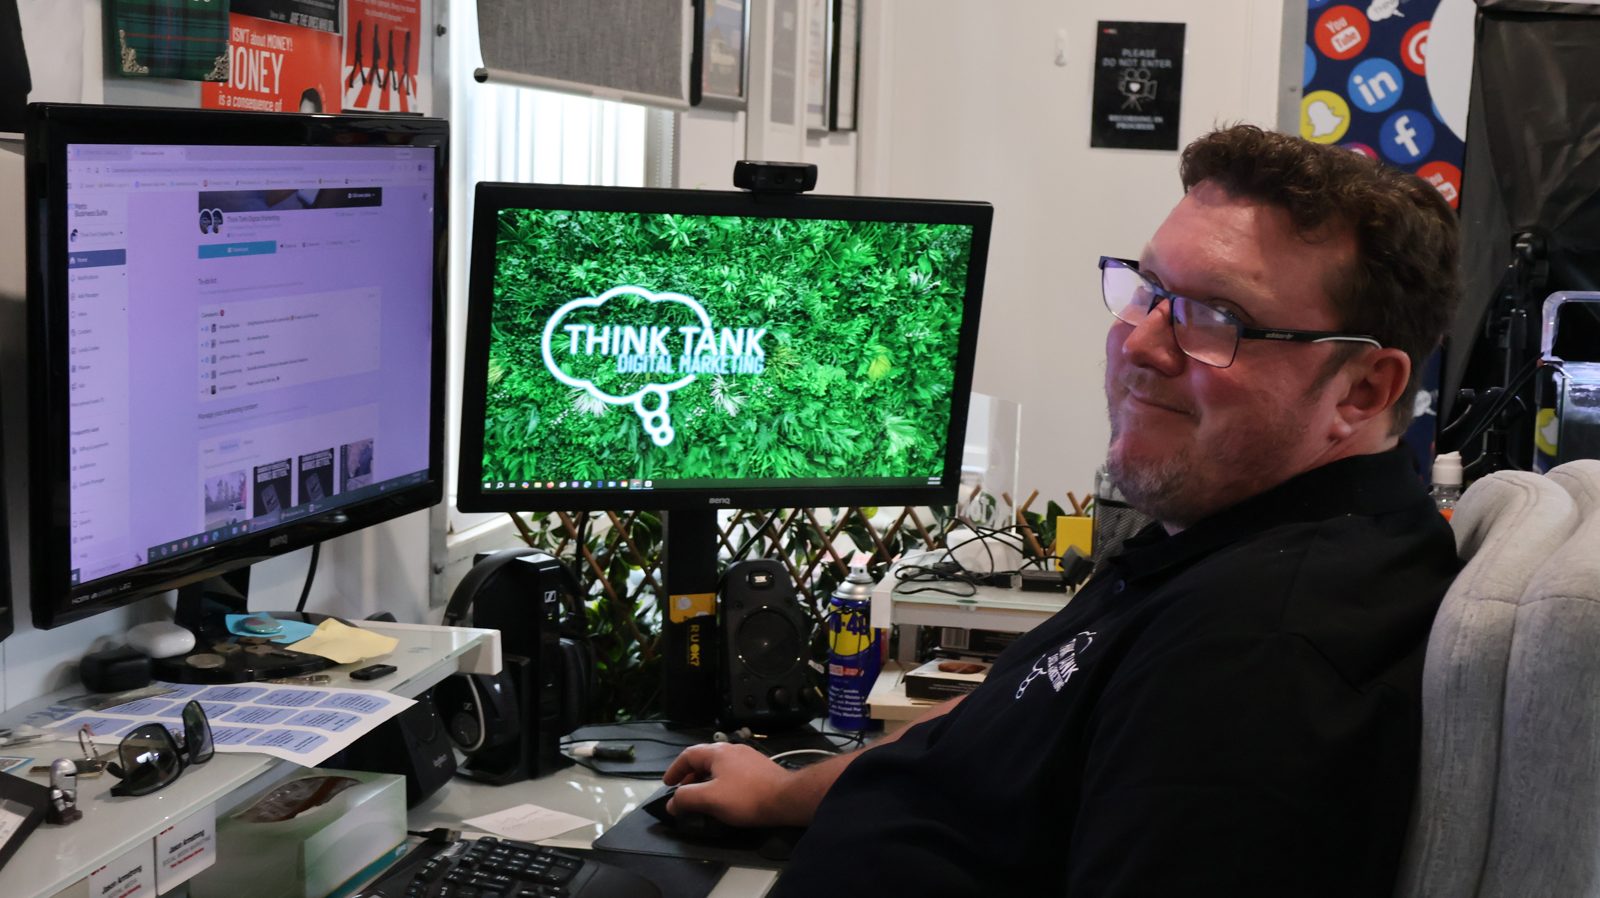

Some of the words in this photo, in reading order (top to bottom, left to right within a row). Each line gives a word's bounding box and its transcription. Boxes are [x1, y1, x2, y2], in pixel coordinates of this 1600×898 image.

[1325, 16, 1348, 34] You
[1121, 48, 1156, 58] PLEASE
[1102, 57, 1117, 67] DO
[1118, 59, 1138, 67] NOT
[1141, 59, 1172, 68] ENTER
[564, 324, 670, 356] THINK
[678, 326, 766, 356] TANK
[616, 354, 674, 374] DIGITAL
[678, 355, 765, 375] MARKETING
